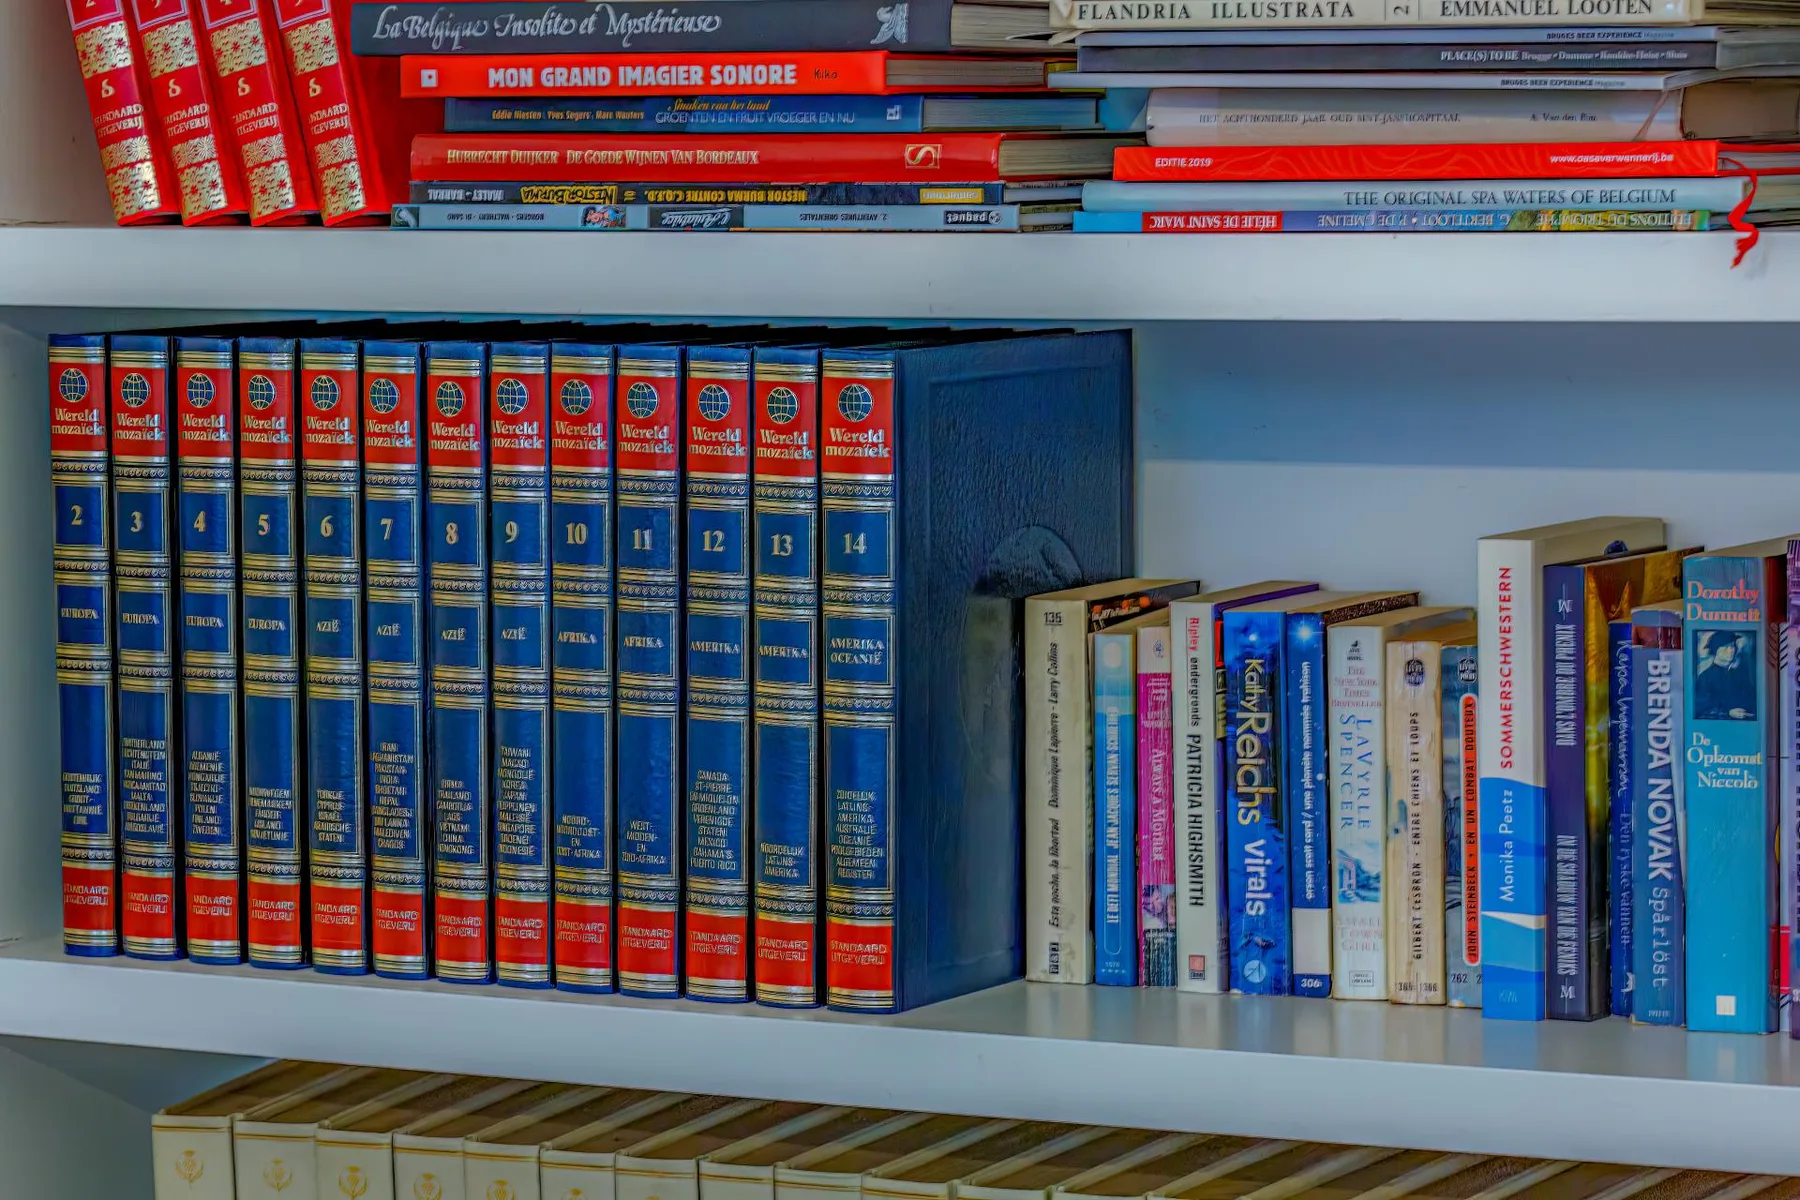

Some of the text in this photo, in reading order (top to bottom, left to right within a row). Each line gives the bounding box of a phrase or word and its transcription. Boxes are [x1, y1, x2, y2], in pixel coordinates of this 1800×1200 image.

[1078, 0, 1355, 21] FLANDRIA ILLUSTRATA
[1440, 0, 1652, 17] EMMANUEL LOOTEN
[372, 3, 722, 51] La Belgique Insolite et Mystérieuse
[1546, 30, 1643, 40] BRUGES BEER EXPERIENCE
[1440, 51, 1487, 63] PLACE(S)
[488, 63, 797, 88] MON GRAND IMAGIER SONORE
[1500, 78, 1594, 88] BRUGES BEER EXPERIENCE
[446, 149, 759, 166] HUBRECHT DUIJKER DE GOEDE WIJNEN VAN BORDEAUX
[1155, 157, 1186, 168] EDITIE
[726, 190, 766, 202] BURMA
[1343, 189, 1677, 206] THE ORIGINAL SPA WATERS OF BELGIUM
[946, 211, 988, 224] paquet
[1149, 213, 1277, 231] HÉLIE DE SAINT MARC
[55, 408, 99, 422] Wereld
[117, 414, 161, 428] Wereld
[183, 414, 226, 428] Wereld
[244, 416, 287, 430] Wereld
[307, 416, 350, 431] Wereld
[365, 419, 411, 434] Wereld
[431, 422, 476, 437] Wereld
[493, 421, 539, 435] Wereld
[555, 421, 604, 436] Wereld
[621, 424, 671, 439] Wereld
[692, 427, 742, 442] Wereld
[830, 428, 886, 443] Wereld
[760, 429, 809, 445] Wereld
[71, 505, 83, 525] 2
[130, 511, 144, 532] 3
[194, 510, 206, 532] 4
[257, 514, 270, 536] 5
[320, 515, 334, 538] 6
[380, 518, 394, 541] 7
[446, 522, 459, 545] 8
[506, 521, 520, 544] 9
[566, 522, 587, 545] 10
[633, 529, 653, 550] 11
[702, 530, 725, 552] 12
[771, 533, 794, 556] 13
[843, 532, 867, 554] 14
[1687, 579, 1760, 604] Dorothy
[1044, 611, 1062, 625] 135
[1686, 602, 1761, 622] Dunnett
[316, 618, 340, 633] AZIË
[376, 622, 400, 636] AZIË
[441, 627, 466, 641] AZIË
[501, 626, 526, 640] AZIË
[1188, 617, 1200, 652] Ripley
[557, 631, 597, 645] AFRIKA
[623, 636, 664, 648] AFRIKA
[690, 640, 741, 654] AMERIKA
[829, 637, 885, 651] AMERIKA
[757, 645, 808, 659] AMERIKA
[829, 650, 883, 665] OCEANIË
[1046, 641, 1059, 677] Collins
[1498, 567, 1513, 769] SOMMERSCHWESTERN
[1555, 661, 1577, 676] DU
[1047, 678, 1061, 705] Larry
[1646, 659, 1672, 769] BRENDA
[1236, 658, 1278, 825] Kathy Reichs
[1555, 720, 1577, 747] DANS
[1691, 732, 1711, 747] De
[1151, 747, 1168, 796] ALWAYS
[1339, 713, 1357, 831] SPENCER
[1357, 717, 1373, 830] LAVYRLE
[1697, 770, 1758, 790] Niccolò
[1717, 766, 1741, 776] van
[1047, 755, 1062, 809] Dominique
[1186, 733, 1205, 908] PATRICIA HIGHSMITH
[1464, 702, 1477, 958] JOHN STEINBECK EN UN COMBAT DOUTEUX
[1619, 812, 1632, 845] Den
[1647, 777, 1675, 882] NOVAK
[1151, 808, 1168, 862] MOTHER
[1409, 711, 1424, 960] GILBERT CESBRON ENTRE CHIENS ET LOUPS
[1499, 789, 1515, 902] Monika Peetz
[1243, 839, 1274, 917] virals
[1048, 905, 1060, 928] Esta
[1648, 886, 1674, 988] Spårlöst
[1556, 939, 1578, 976] FENIKS
